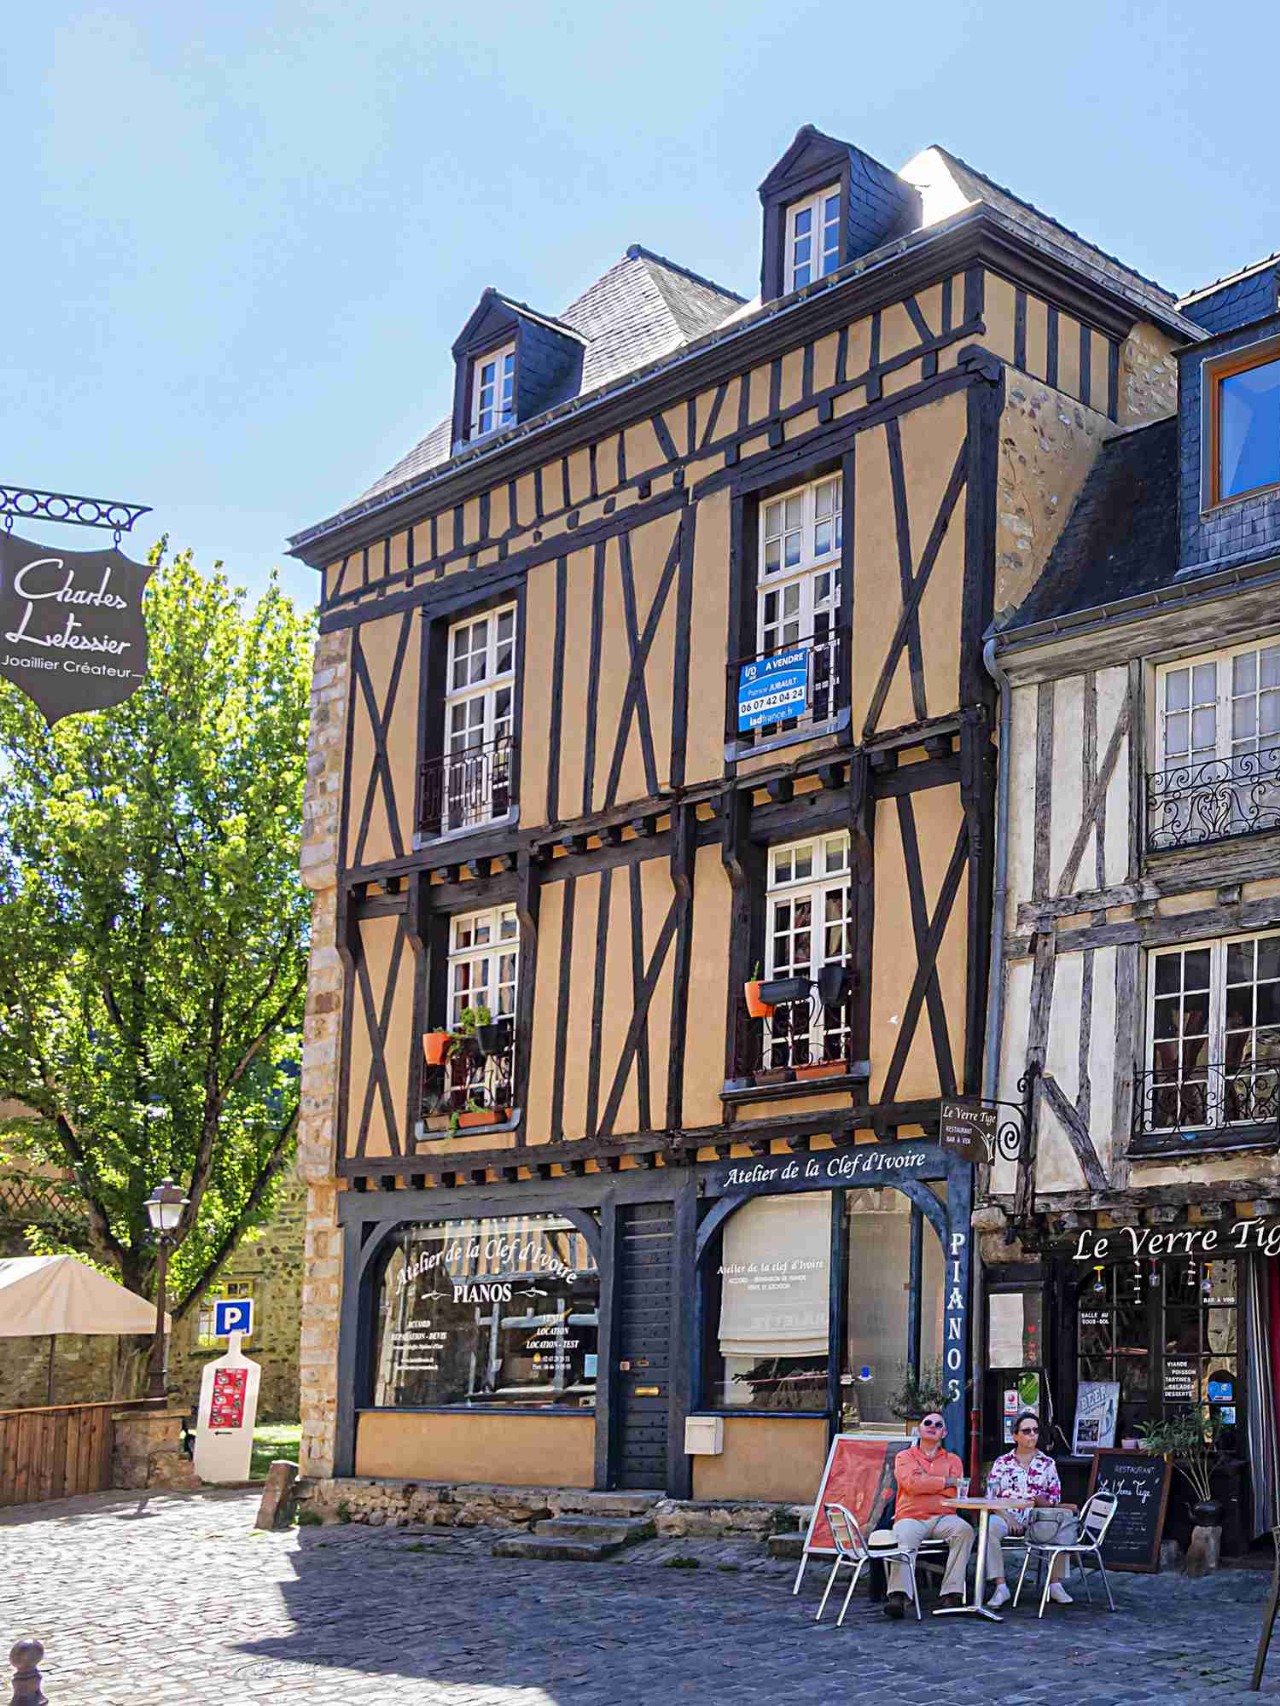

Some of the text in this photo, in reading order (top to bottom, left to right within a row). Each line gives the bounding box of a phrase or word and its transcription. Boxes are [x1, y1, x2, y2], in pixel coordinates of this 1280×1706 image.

[14, 558, 127, 610] Charles
[5, 601, 131, 655] Letessier
[1, 655, 131, 678] Joaillier Créateur
[772, 652, 804, 668] VENDRE
[741, 703, 752, 714] 06
[753, 700, 764, 711] 07
[766, 695, 777, 706] 42
[779, 691, 790, 702] 04
[792, 689, 803, 699] 24
[943, 1105, 997, 1126] Le Verre Tige
[723, 1150, 926, 1187] Atelier de la Clef d'Ivoire
[1072, 1229, 1109, 1260] Le
[1119, 1226, 1218, 1255] Verre
[396, 1236, 577, 1295] Atelier de la Clef d'Ivoire
[717, 1263, 746, 1275] Atelier
[747, 1262, 759, 1273] de
[761, 1261, 770, 1272] la
[453, 1283, 512, 1303] PIANOS
[225, 1307, 242, 1330] P
[947, 1233, 965, 1402] PIANOS
[536, 1326, 570, 1336] LOCATION
[526, 1340, 558, 1349] LOCATION
[563, 1340, 579, 1349] TEST
[1081, 1385, 1107, 1410] BEER
[1115, 1465, 1155, 1475] RESTAURANT
[1133, 1480, 1152, 1504] Tige
